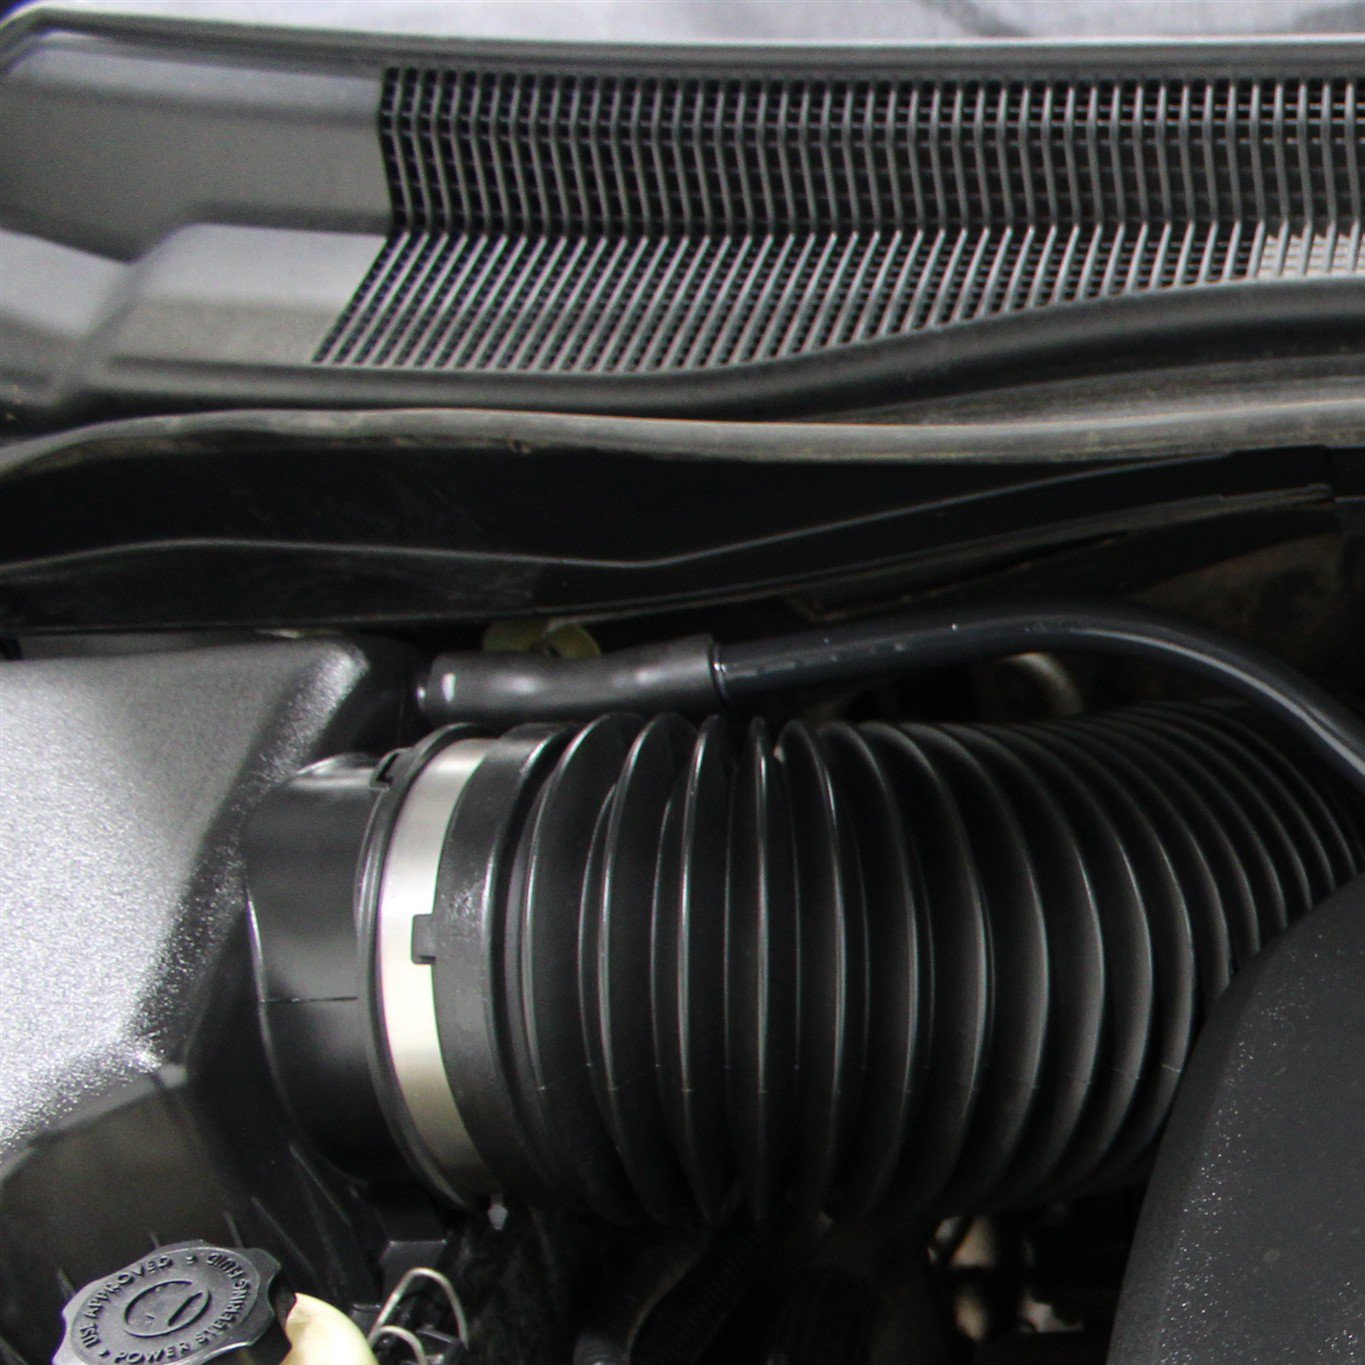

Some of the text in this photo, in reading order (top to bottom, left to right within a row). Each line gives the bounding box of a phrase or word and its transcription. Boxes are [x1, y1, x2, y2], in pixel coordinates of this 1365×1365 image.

[84, 1255, 173, 1319] APPROVED
[114, 1342, 190, 1365] POWER
[195, 1279, 251, 1344] STEERING
